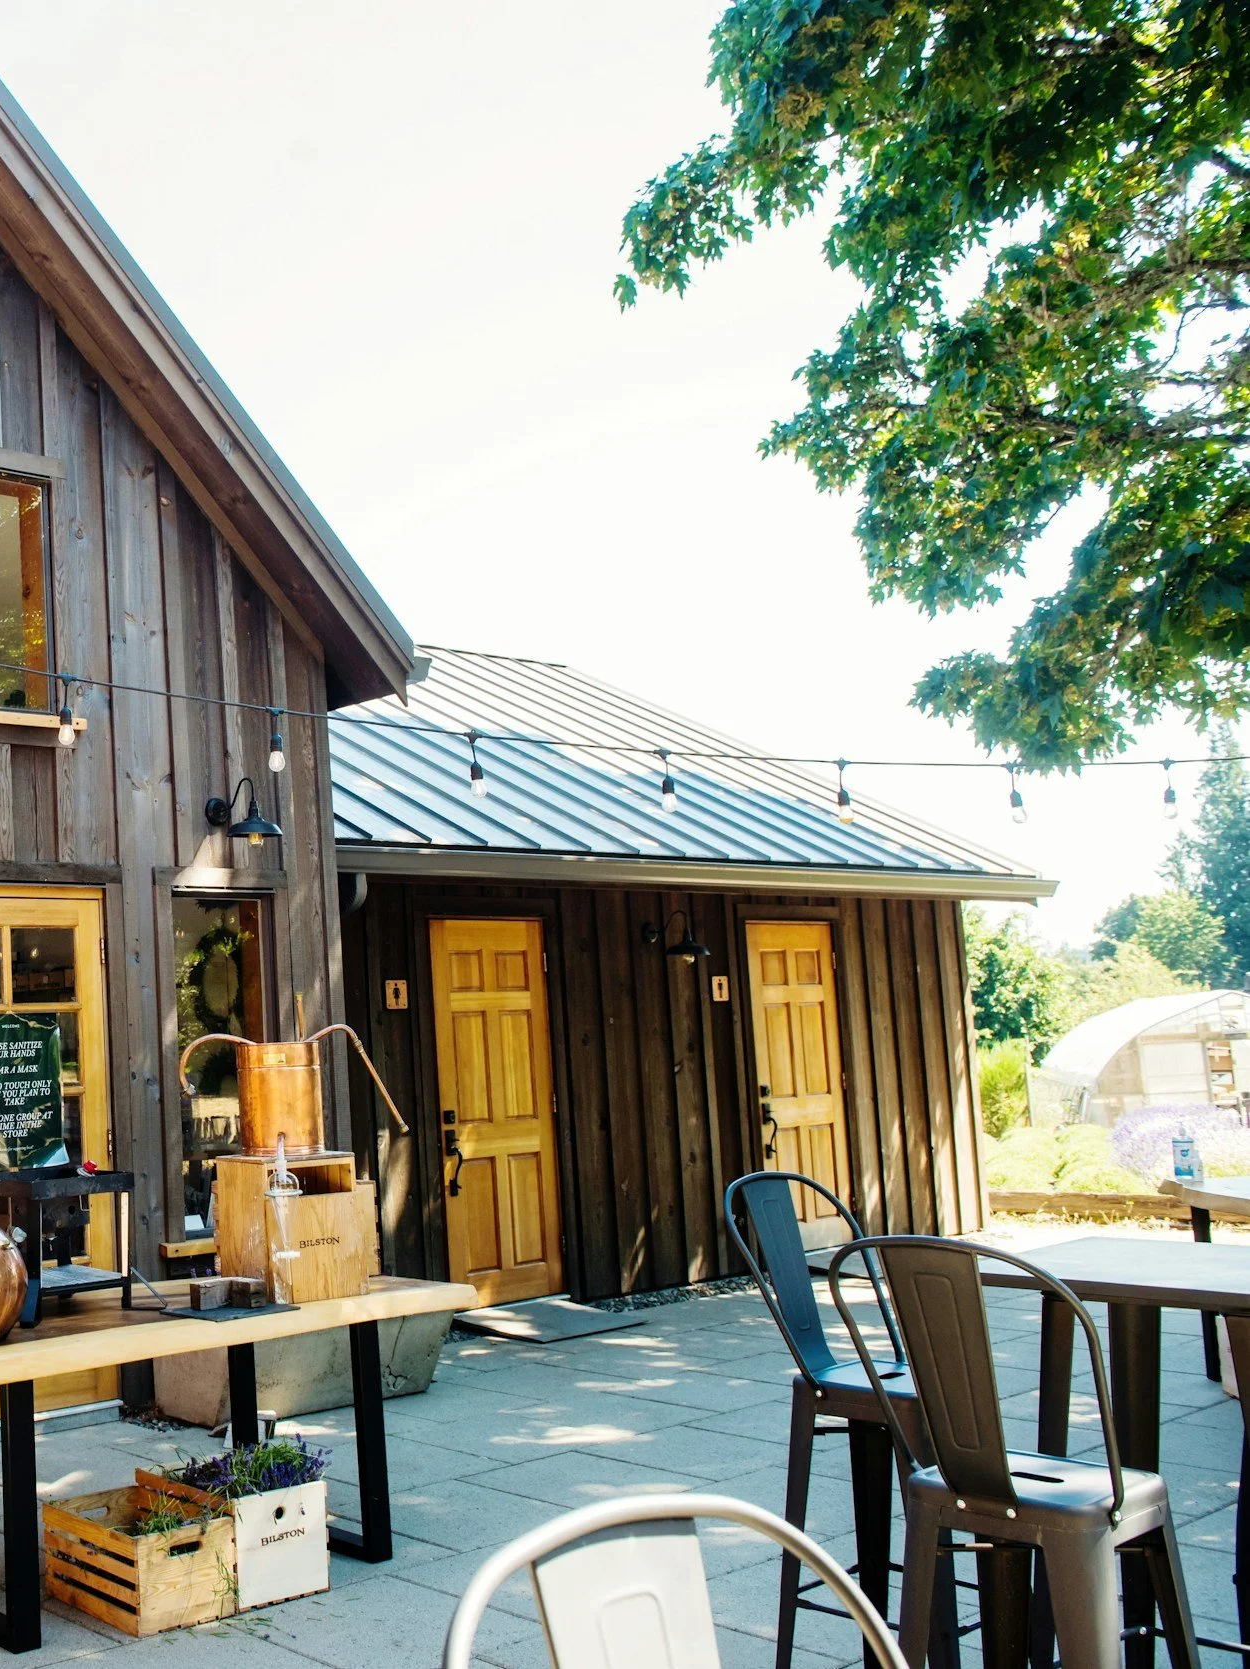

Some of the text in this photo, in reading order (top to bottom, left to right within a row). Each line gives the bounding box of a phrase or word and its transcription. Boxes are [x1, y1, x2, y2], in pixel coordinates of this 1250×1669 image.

[9, 1041, 43, 1050] SANITIZE
[10, 1049, 36, 1058] HANDS
[10, 1066, 16, 1074] A
[17, 1064, 39, 1074] MASK
[4, 1080, 30, 1090] TOUCH
[31, 1079, 52, 1089] ONLY
[2, 1089, 18, 1098] YOU
[19, 1088, 39, 1097] PLAN
[40, 1087, 51, 1096] TO
[4, 1097, 25, 1106] TAKE
[16, 1112, 42, 1121] GROUP
[42, 1111, 53, 1120] AT
[16, 1121, 25, 1130] IN
[25, 1120, 42, 1129] THE
[3, 1129, 29, 1138] STORE
[299, 1236, 340, 1249] BILSTON
[261, 1527, 305, 1546] BILSTON
